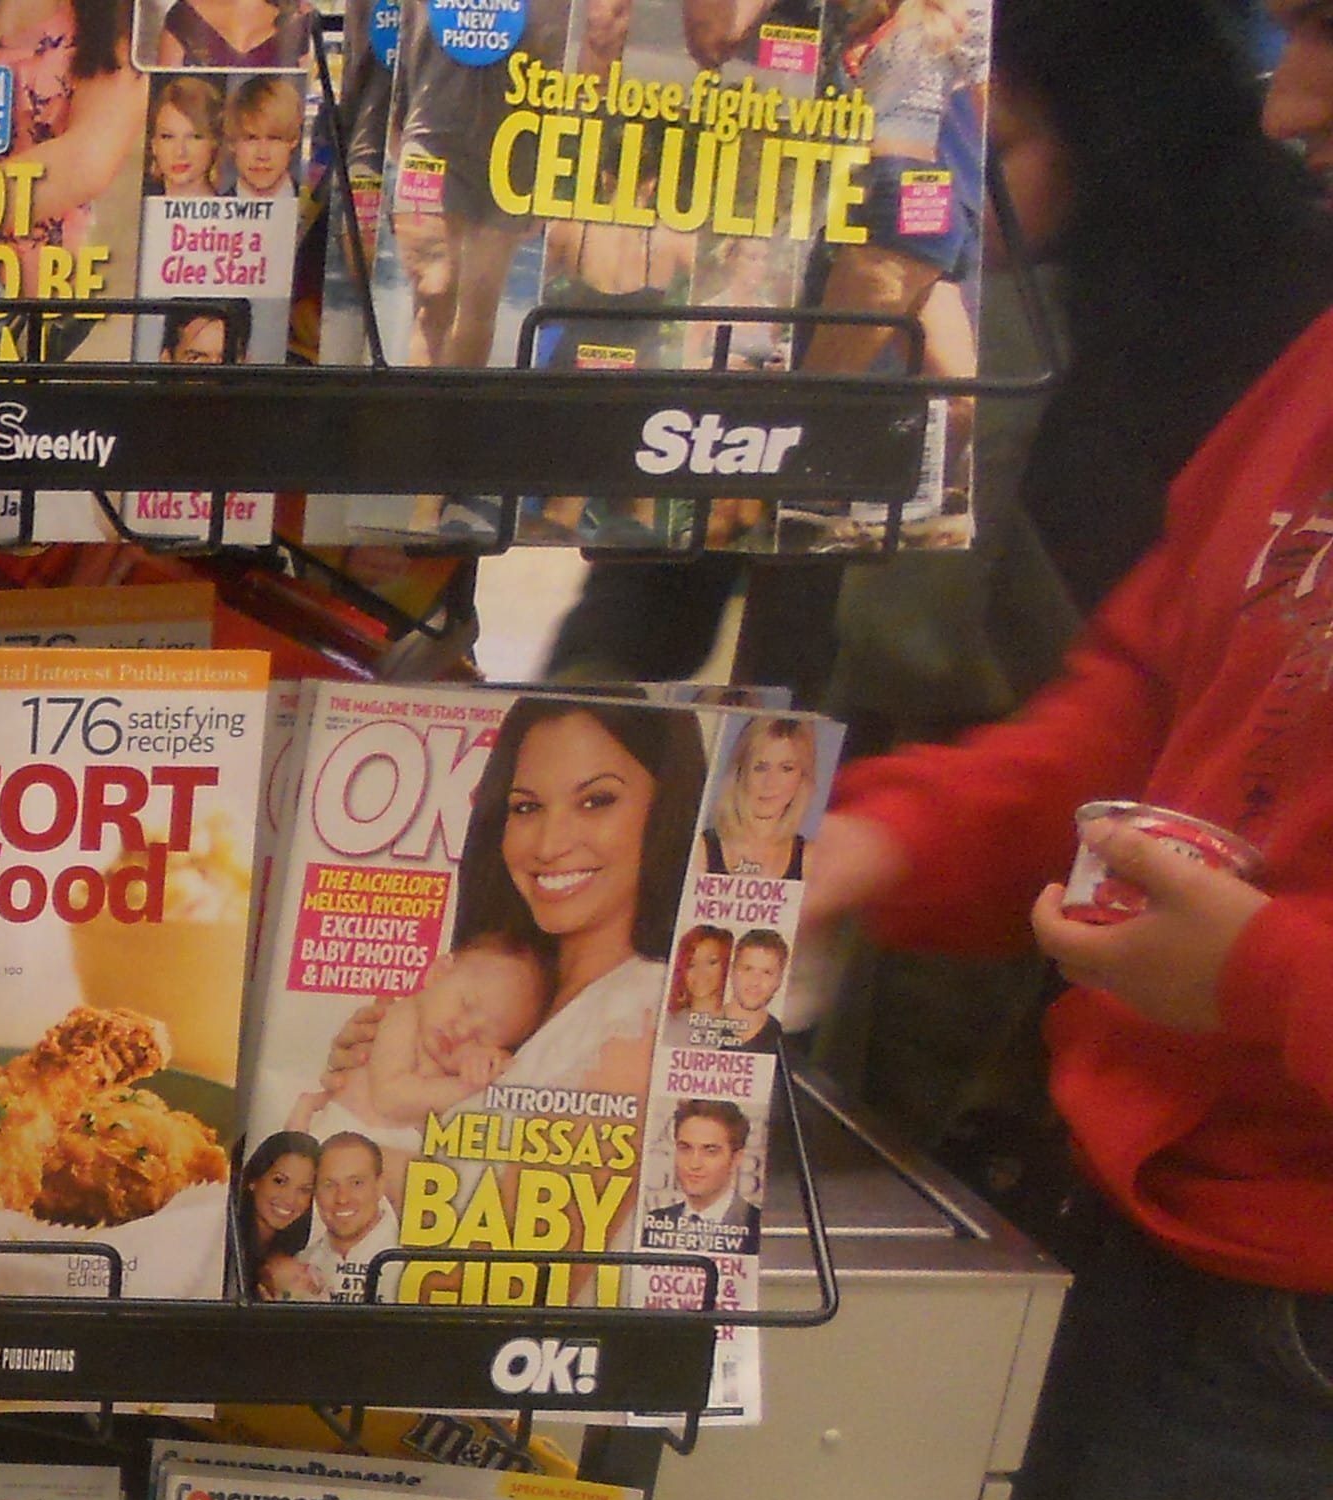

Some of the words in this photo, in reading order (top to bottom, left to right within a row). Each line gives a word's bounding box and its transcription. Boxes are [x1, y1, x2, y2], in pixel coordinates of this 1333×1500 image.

[457, 12, 496, 31] NEW
[442, 28, 510, 51] PHOTOS
[505, 53, 599, 113] Stars
[608, 66, 676, 117] lose
[691, 63, 781, 144] fight
[790, 89, 874, 141] with
[489, 109, 871, 245] CELLULITE
[164, 201, 221, 220] TAYLOR
[224, 201, 273, 221] SWIFT
[171, 224, 243, 256] Dating
[249, 234, 261, 253] a
[160, 258, 216, 285] Glee
[220, 257, 267, 285] Star!
[636, 409, 802, 476] Star
[22, 697, 123, 756] 176
[128, 706, 245, 739] satisfying
[126, 733, 215, 758] recipes
[694, 876, 732, 897] NEW
[734, 879, 787, 903] LOOK,
[694, 900, 731, 920] NEW
[735, 902, 780, 924] LOVE
[321, 916, 417, 942] EXCLUSIVE
[301, 942, 352, 964] BABY
[354, 943, 427, 967] PHOTOS
[301, 966, 317, 984] &
[320, 966, 420, 991] INTERVIEW
[670, 1051, 755, 1076] SURPRISE
[667, 1076, 753, 1097] ROMANCE
[485, 1085, 637, 1117] INTRODUCING
[423, 1111, 637, 1171] MELISSA'S
[399, 1161, 632, 1251] BABY
[492, 1339, 600, 1396] OK!
